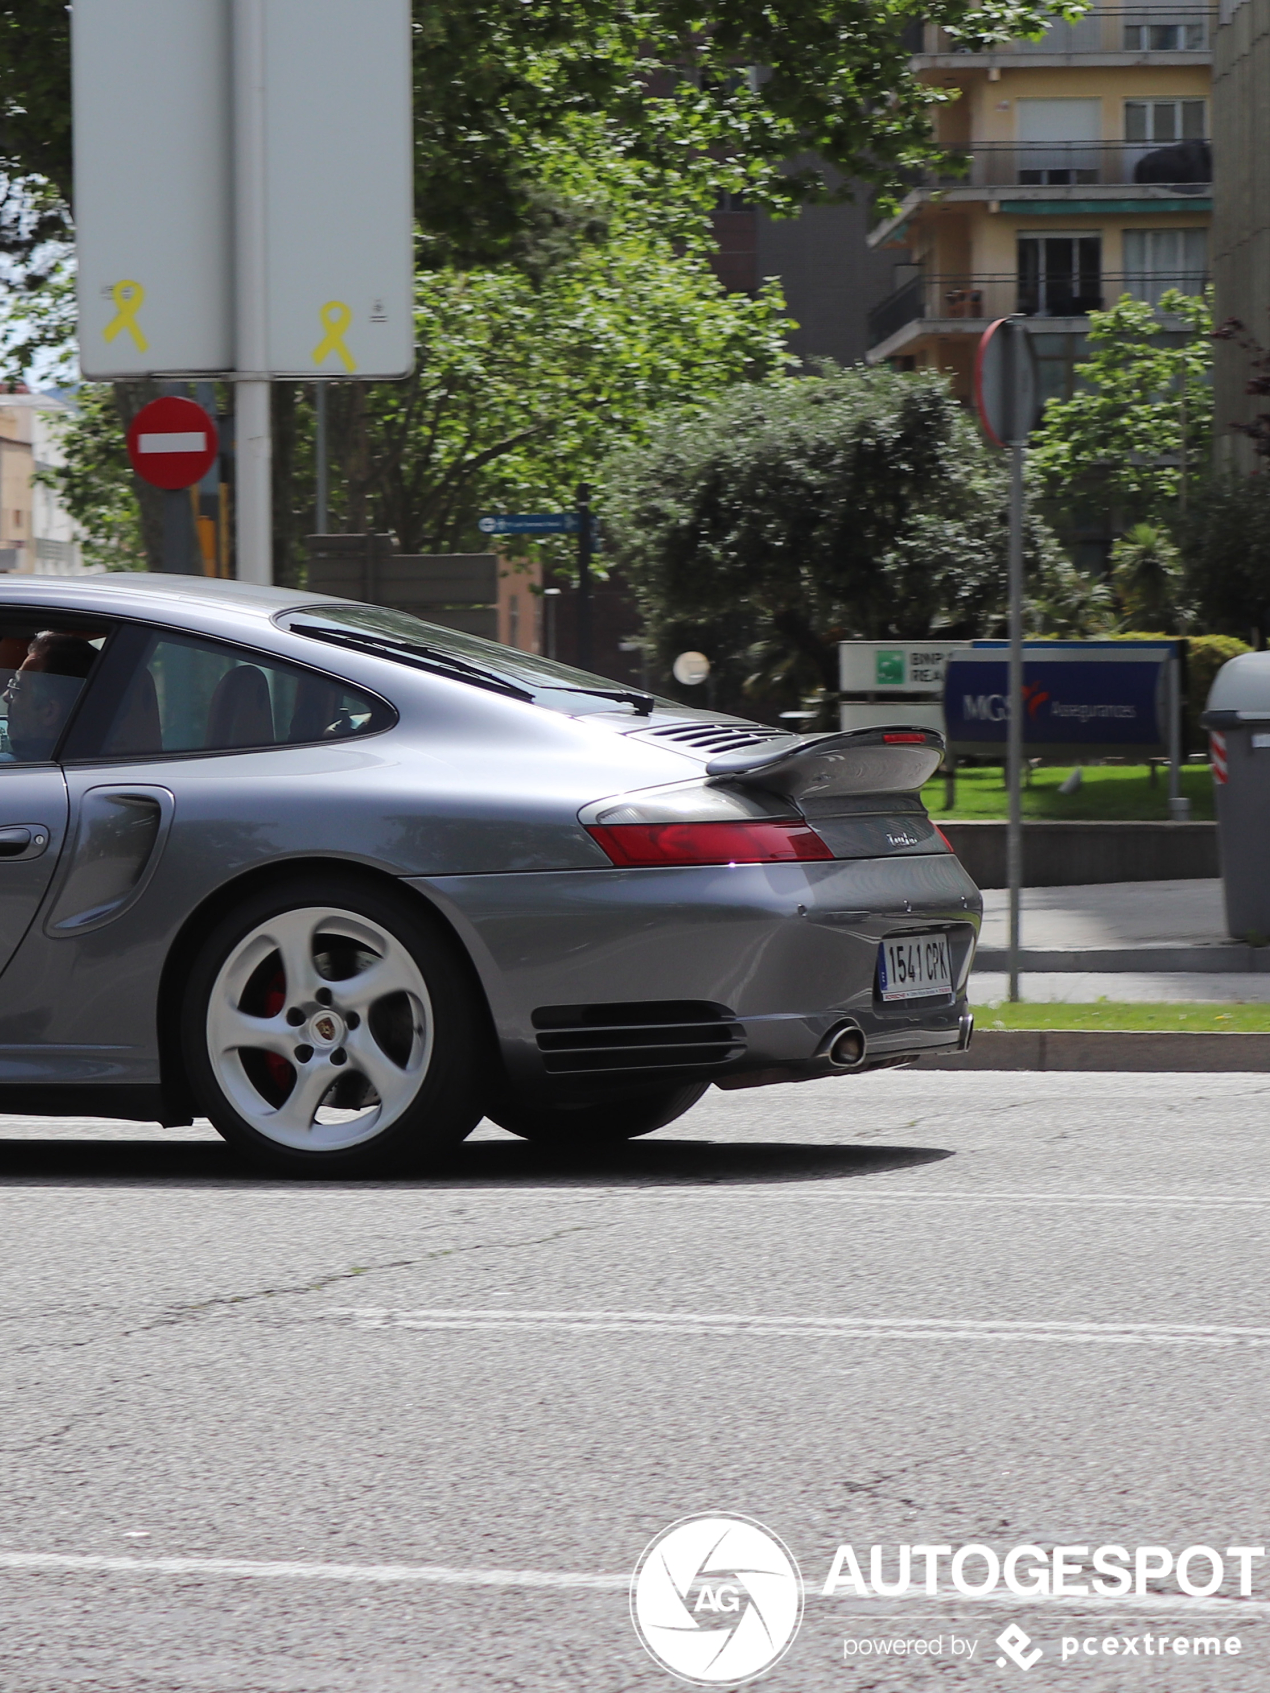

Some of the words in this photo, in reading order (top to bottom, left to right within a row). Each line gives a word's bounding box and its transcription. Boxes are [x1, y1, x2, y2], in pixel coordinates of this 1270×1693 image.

[910, 652, 944, 666] BNP
[1051, 700, 1137, 723] Assegurances
[889, 944, 922, 985] 1541
[926, 942, 948, 981] CPK
